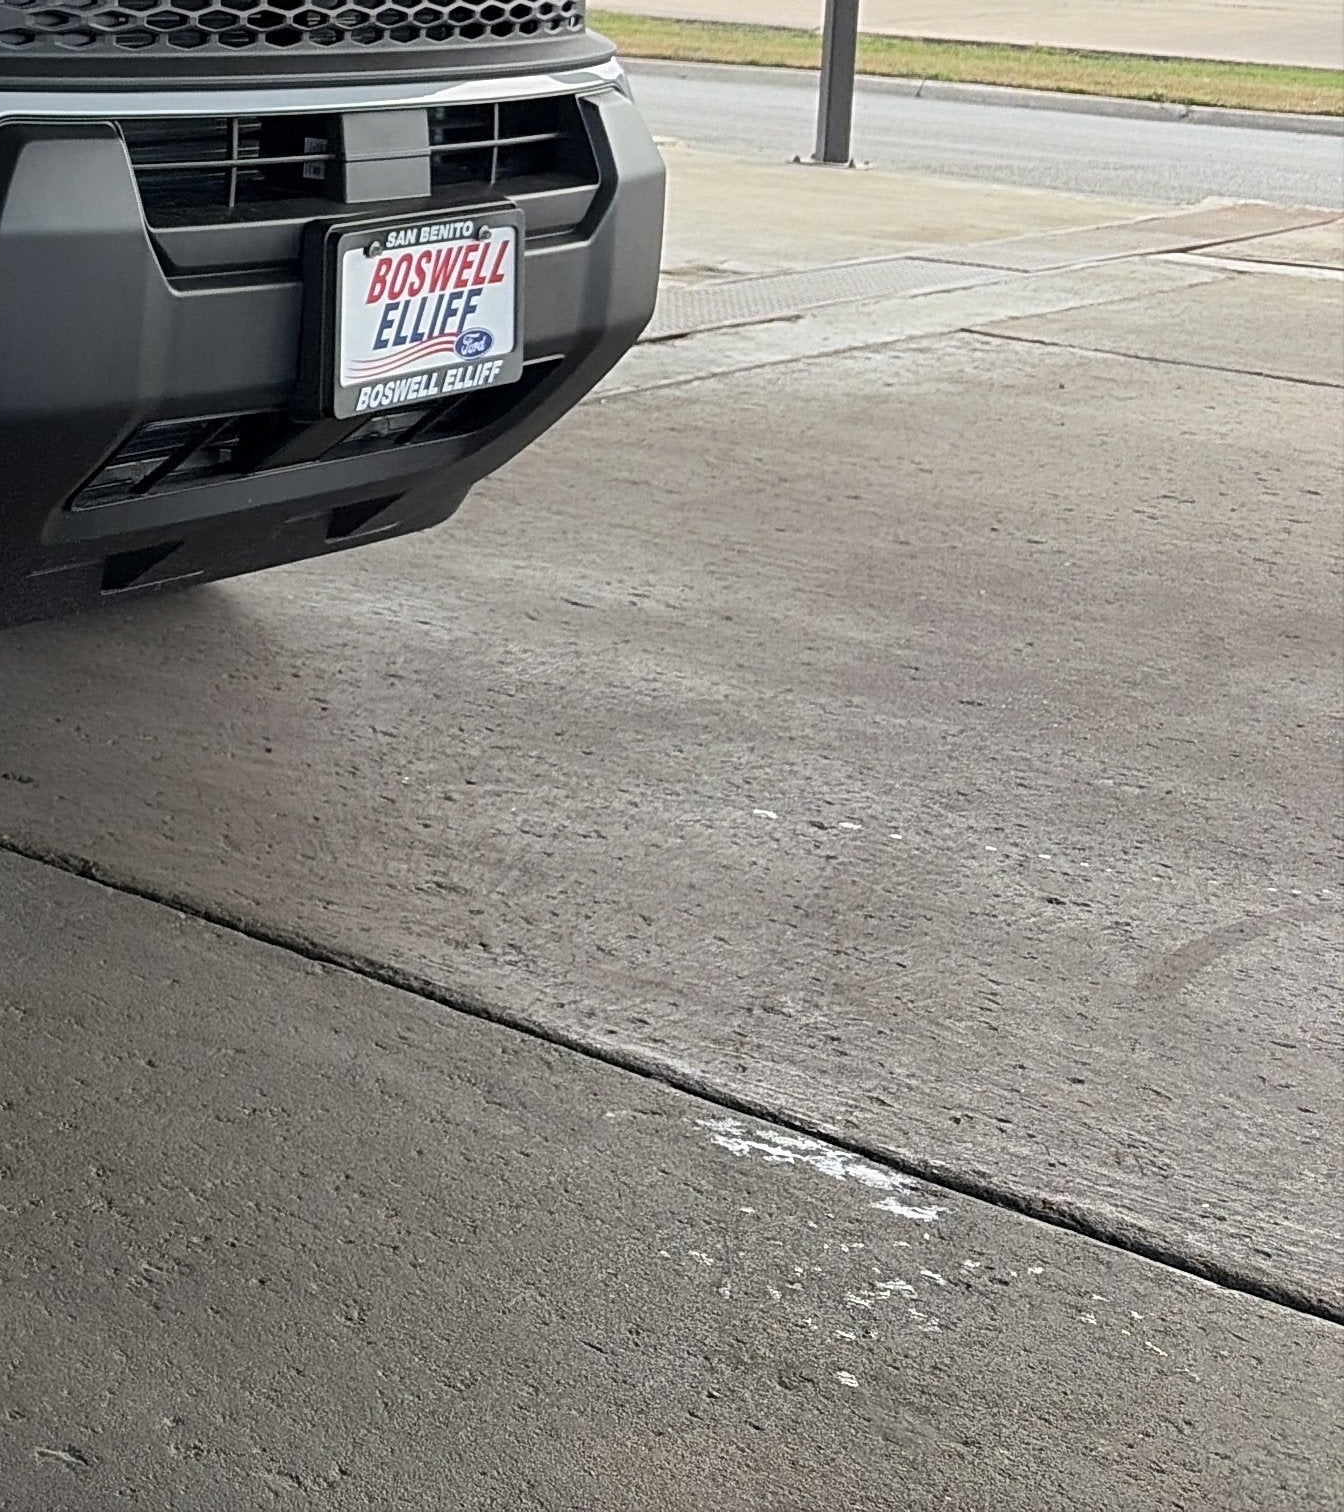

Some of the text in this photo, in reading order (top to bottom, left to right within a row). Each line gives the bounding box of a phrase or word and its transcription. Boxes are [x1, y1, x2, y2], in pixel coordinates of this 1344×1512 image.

[385, 221, 474, 248] SAN BENITO
[365, 240, 510, 304] BOSWELL
[372, 287, 484, 351] ELLIFF
[461, 333, 487, 355] Ford
[355, 360, 503, 412] BOSWELL ELLIFF
